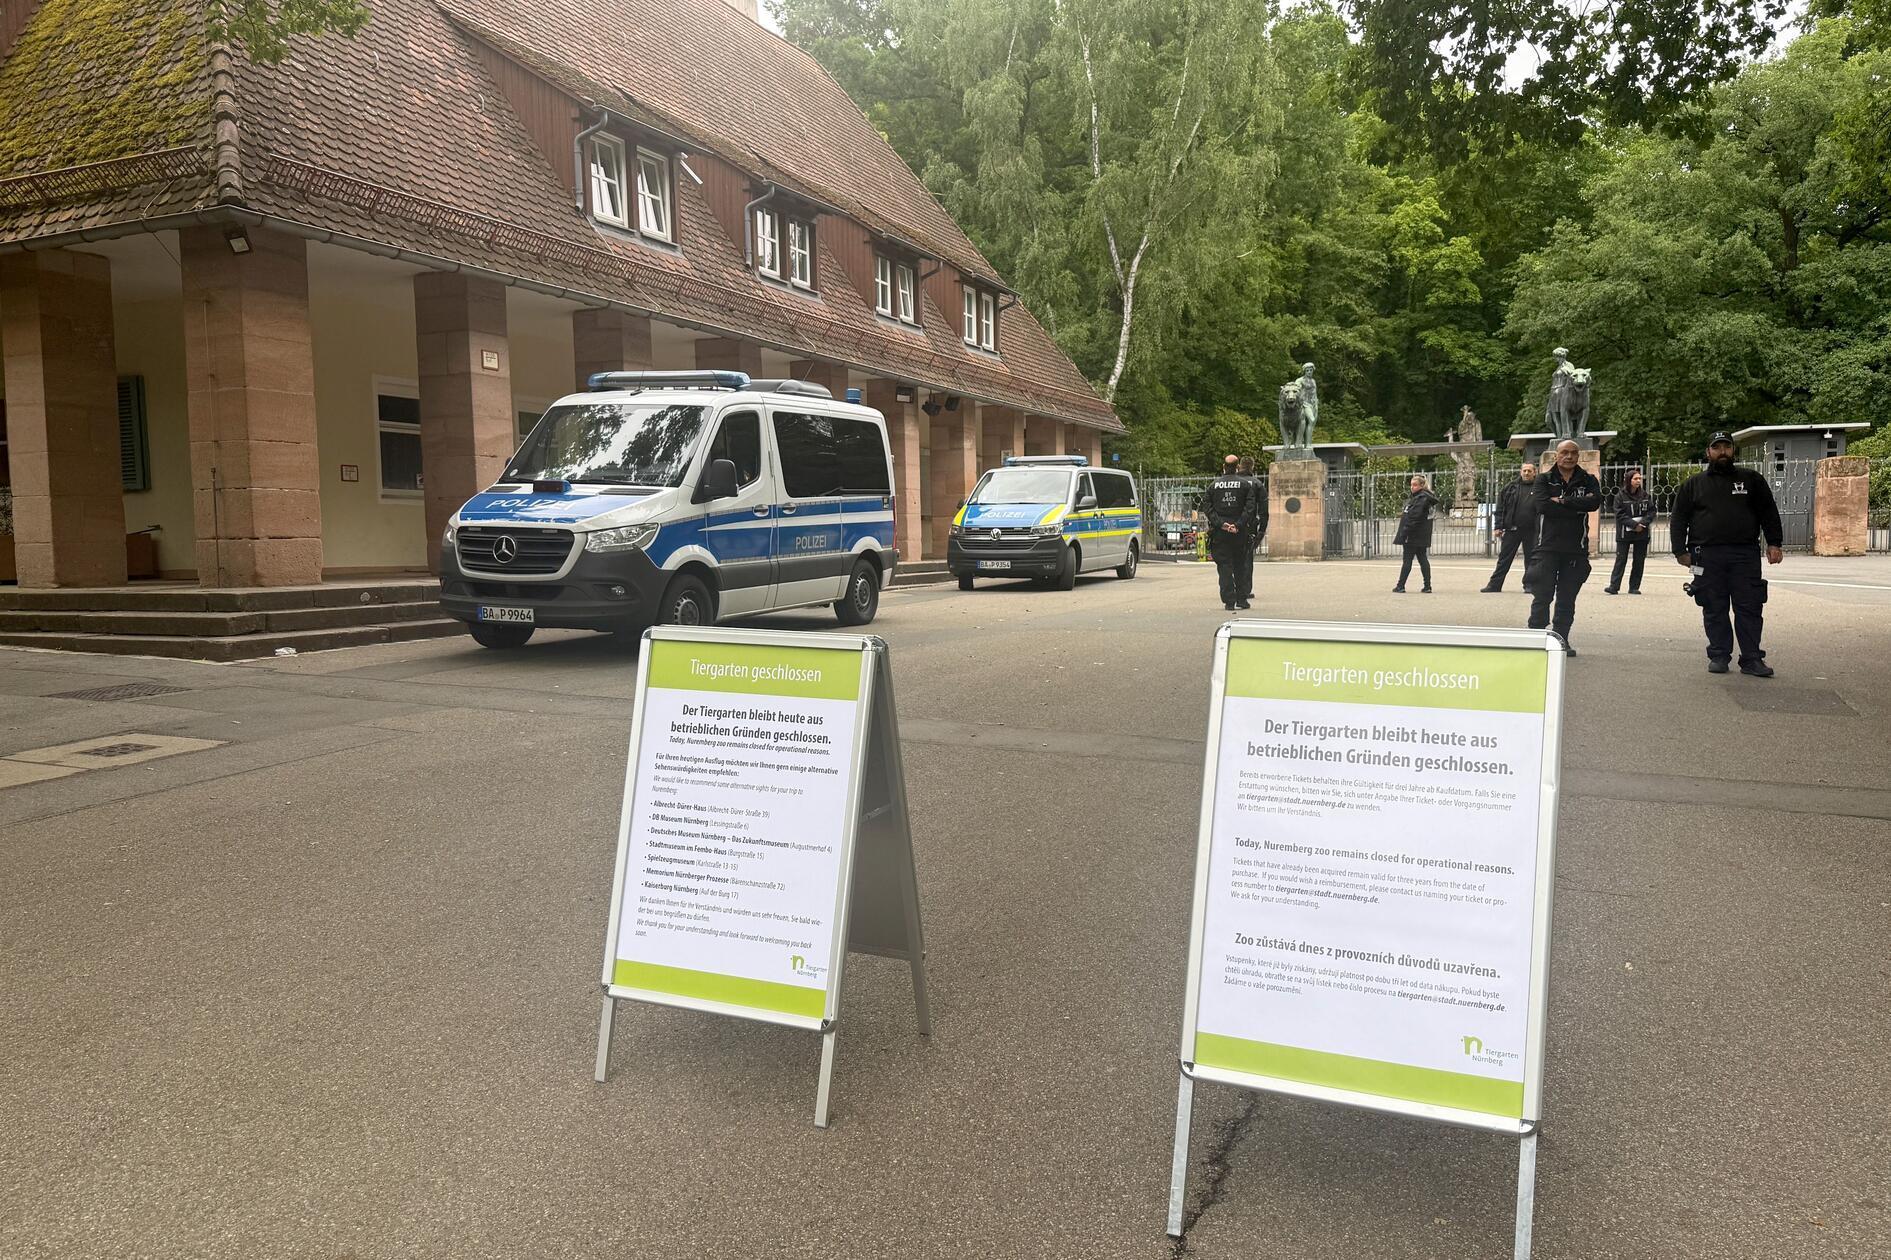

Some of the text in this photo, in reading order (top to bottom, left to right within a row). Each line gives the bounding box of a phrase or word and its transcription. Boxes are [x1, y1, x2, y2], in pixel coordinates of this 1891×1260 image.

[1214, 481, 1240, 489] POLIZEI
[485, 499, 576, 510] POLIZEI
[796, 535, 826, 550] POLIZEI
[482, 607, 494, 619] BA
[507, 609, 532, 620] 9964
[690, 658, 821, 682] Tiergarten geschlossen
[1282, 661, 1479, 689] Tiergarten geschlossen
[682, 704, 823, 725] Der Tiergarten bleibt heute aus
[670, 720, 831, 744] betrieblichen Gründen geschlossen.
[1264, 718, 1497, 748] Der Tiergarten bleibt heute aus
[669, 735, 685, 744] Today,
[686, 736, 716, 748] Nuremberg
[726, 740, 748, 748] remains
[748, 741, 766, 750] closed
[774, 745, 807, 753] operational
[664, 752, 679, 760] Ihren
[679, 754, 704, 764] heutigen
[704, 756, 724, 766] Ausflug
[725, 758, 748, 767] möchten
[759, 761, 775, 769] Ihnen
[789, 763, 807, 773] einige
[807, 765, 838, 775] alternative
[1246, 740, 1513, 775] betrieblichen Gründen geschlossen.
[654, 762, 739, 776] Sehenswürdigkeiten empfehlen:
[761, 810, 770, 818] 39)
[1236, 802, 1247, 810] Wir
[1247, 803, 1265, 812] bitten
[1277, 806, 1286, 814] Ihr
[648, 839, 685, 850] Stadtmuseum
[756, 852, 764, 860] 15)
[1234, 836, 1514, 874] Today, Nuremberg zoo remains closed for operational reasons.
[1232, 856, 1485, 892] Tickets that have already been acquired remain valid for three years from the date of
[1243, 881, 1267, 890] number
[1268, 883, 1274, 891] to
[1267, 873, 1278, 881] you
[1279, 874, 1298, 882] would
[1298, 875, 1313, 884] wish
[1368, 883, 1389, 894] please
[1389, 887, 1413, 895] contact
[1422, 890, 1448, 901] naming
[1449, 894, 1464, 902] your
[1464, 894, 1483, 903] ticket
[1230, 890, 1240, 898] We
[1251, 892, 1259, 900] for
[1260, 895, 1274, 903] your
[1234, 932, 1500, 978] Zoo zůstává dnes z provozních důvodů uzavřena.
[1471, 1054, 1503, 1066] Nürnberg
[1485, 1048, 1518, 1059] Tiergarten
